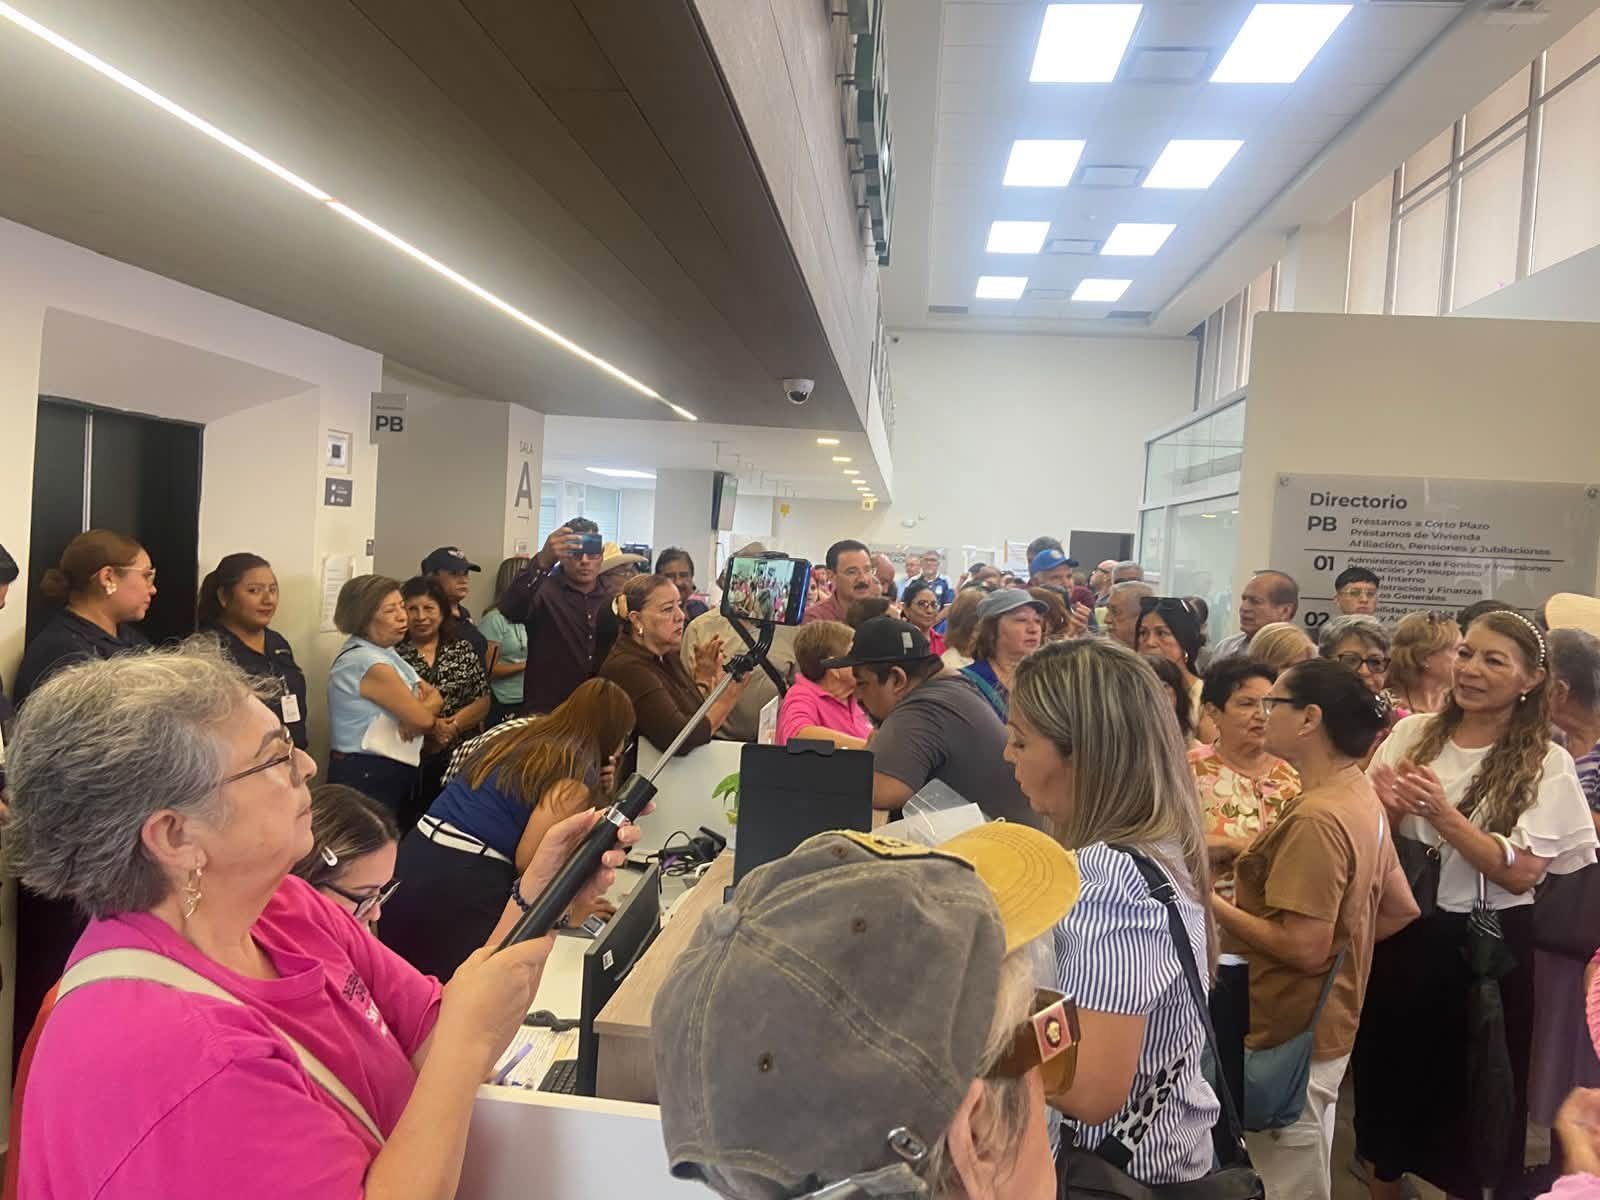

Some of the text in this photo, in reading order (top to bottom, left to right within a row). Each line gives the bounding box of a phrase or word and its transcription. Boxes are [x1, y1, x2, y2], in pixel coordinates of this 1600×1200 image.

[376, 415, 404, 433] PB
[514, 461, 533, 510] A
[1310, 491, 1408, 510] Directorio
[1307, 516, 1338, 532] PB
[1351, 517, 1412, 527] Préstamos
[1424, 520, 1457, 529] Corto
[1459, 521, 1490, 530] Plazo
[1350, 528, 1481, 541] Préstamos de Vivienda
[1349, 539, 1551, 556] Afiliación, Pensiones y Jubilaciones
[1313, 555, 1335, 571] 01
[1348, 556, 1426, 567] Administración
[1427, 560, 1441, 568] de
[1407, 568, 1414, 576] y
[1415, 567, 1482, 577] Presupuesto
[1387, 575, 1426, 584] Interno
[1393, 592, 1447, 602] Generales
[1427, 587, 1435, 595] y
[1436, 586, 1484, 596] Finanzas
[1304, 611, 1330, 627] 02
